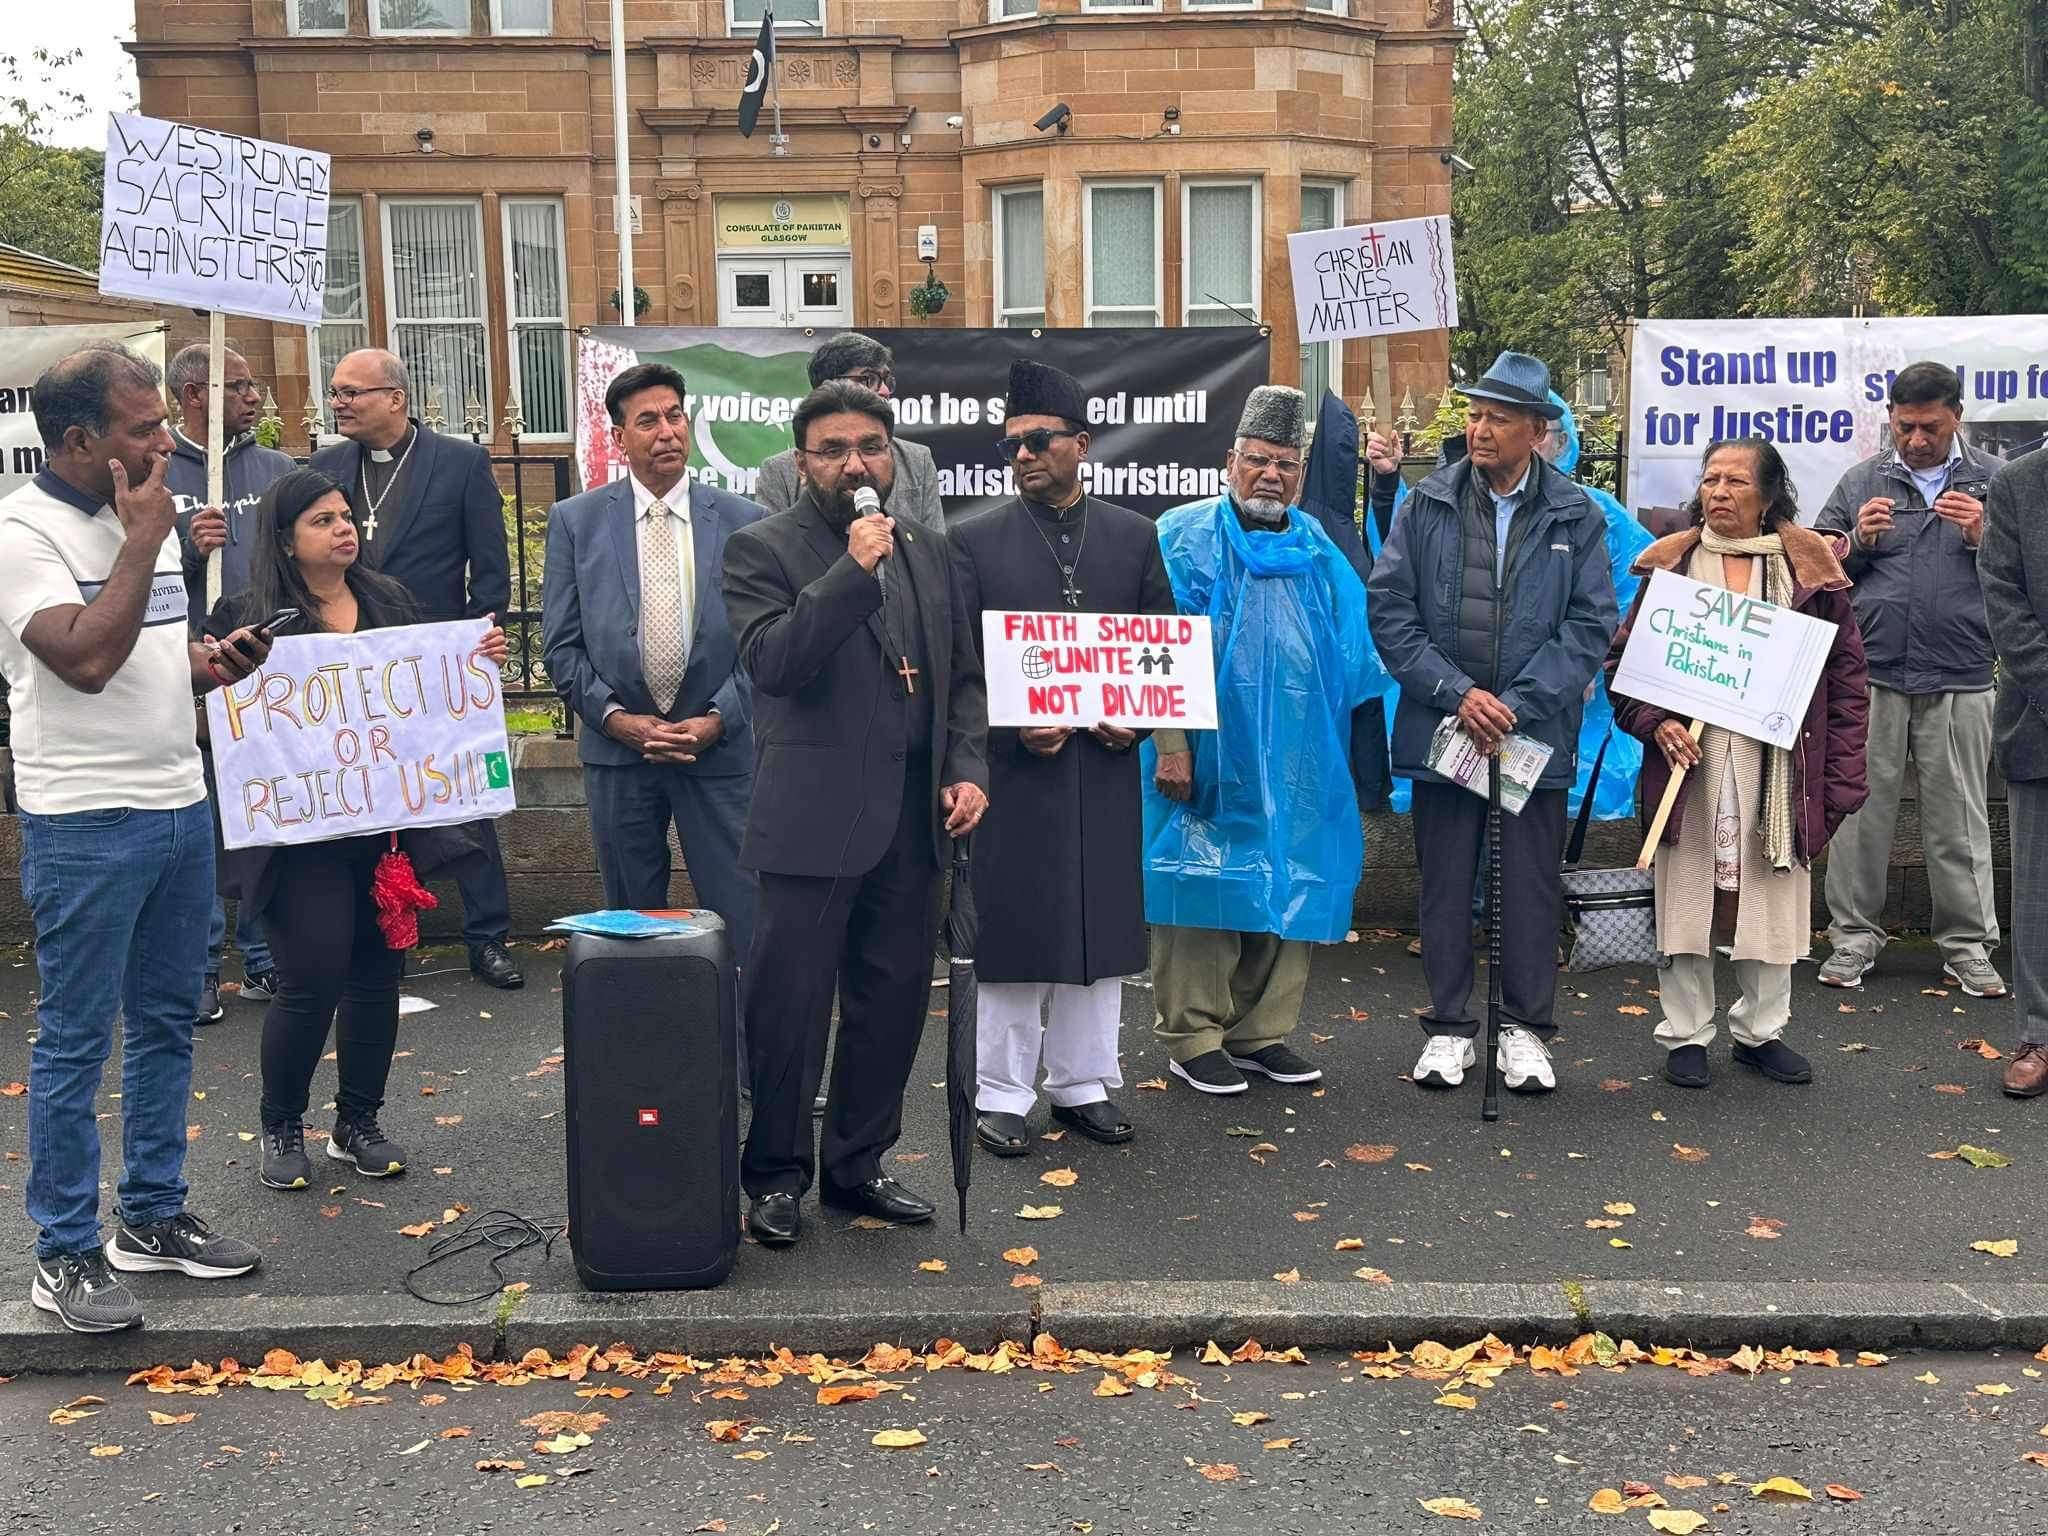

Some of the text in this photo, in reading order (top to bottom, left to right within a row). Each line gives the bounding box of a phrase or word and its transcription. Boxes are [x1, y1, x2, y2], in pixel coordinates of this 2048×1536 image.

[116, 158, 327, 251] SACRILEGE
[726, 224, 780, 232] CONSULATE
[797, 223, 842, 231] PAKISTAN
[1314, 228, 1414, 273] CHRISTIAN
[1319, 267, 1392, 301] LIVES
[1309, 292, 1420, 334] MATTER
[1660, 345, 1777, 386] Stand
[1787, 348, 1836, 387] up
[1974, 370, 2018, 403] up
[940, 392, 980, 425] be
[1133, 390, 1207, 424] until
[1645, 404, 1853, 445] for Justice
[1004, 614, 1192, 645] FAITH SHOULD
[1650, 608, 1753, 661] Christians in
[1690, 588, 1778, 639] SAVE
[1053, 647, 1134, 675] UNITE
[223, 650, 495, 741] PROTECT US
[1028, 683, 1186, 717] NOT DIVIDE
[334, 725, 398, 767] OR
[242, 765, 374, 833] REJECT
